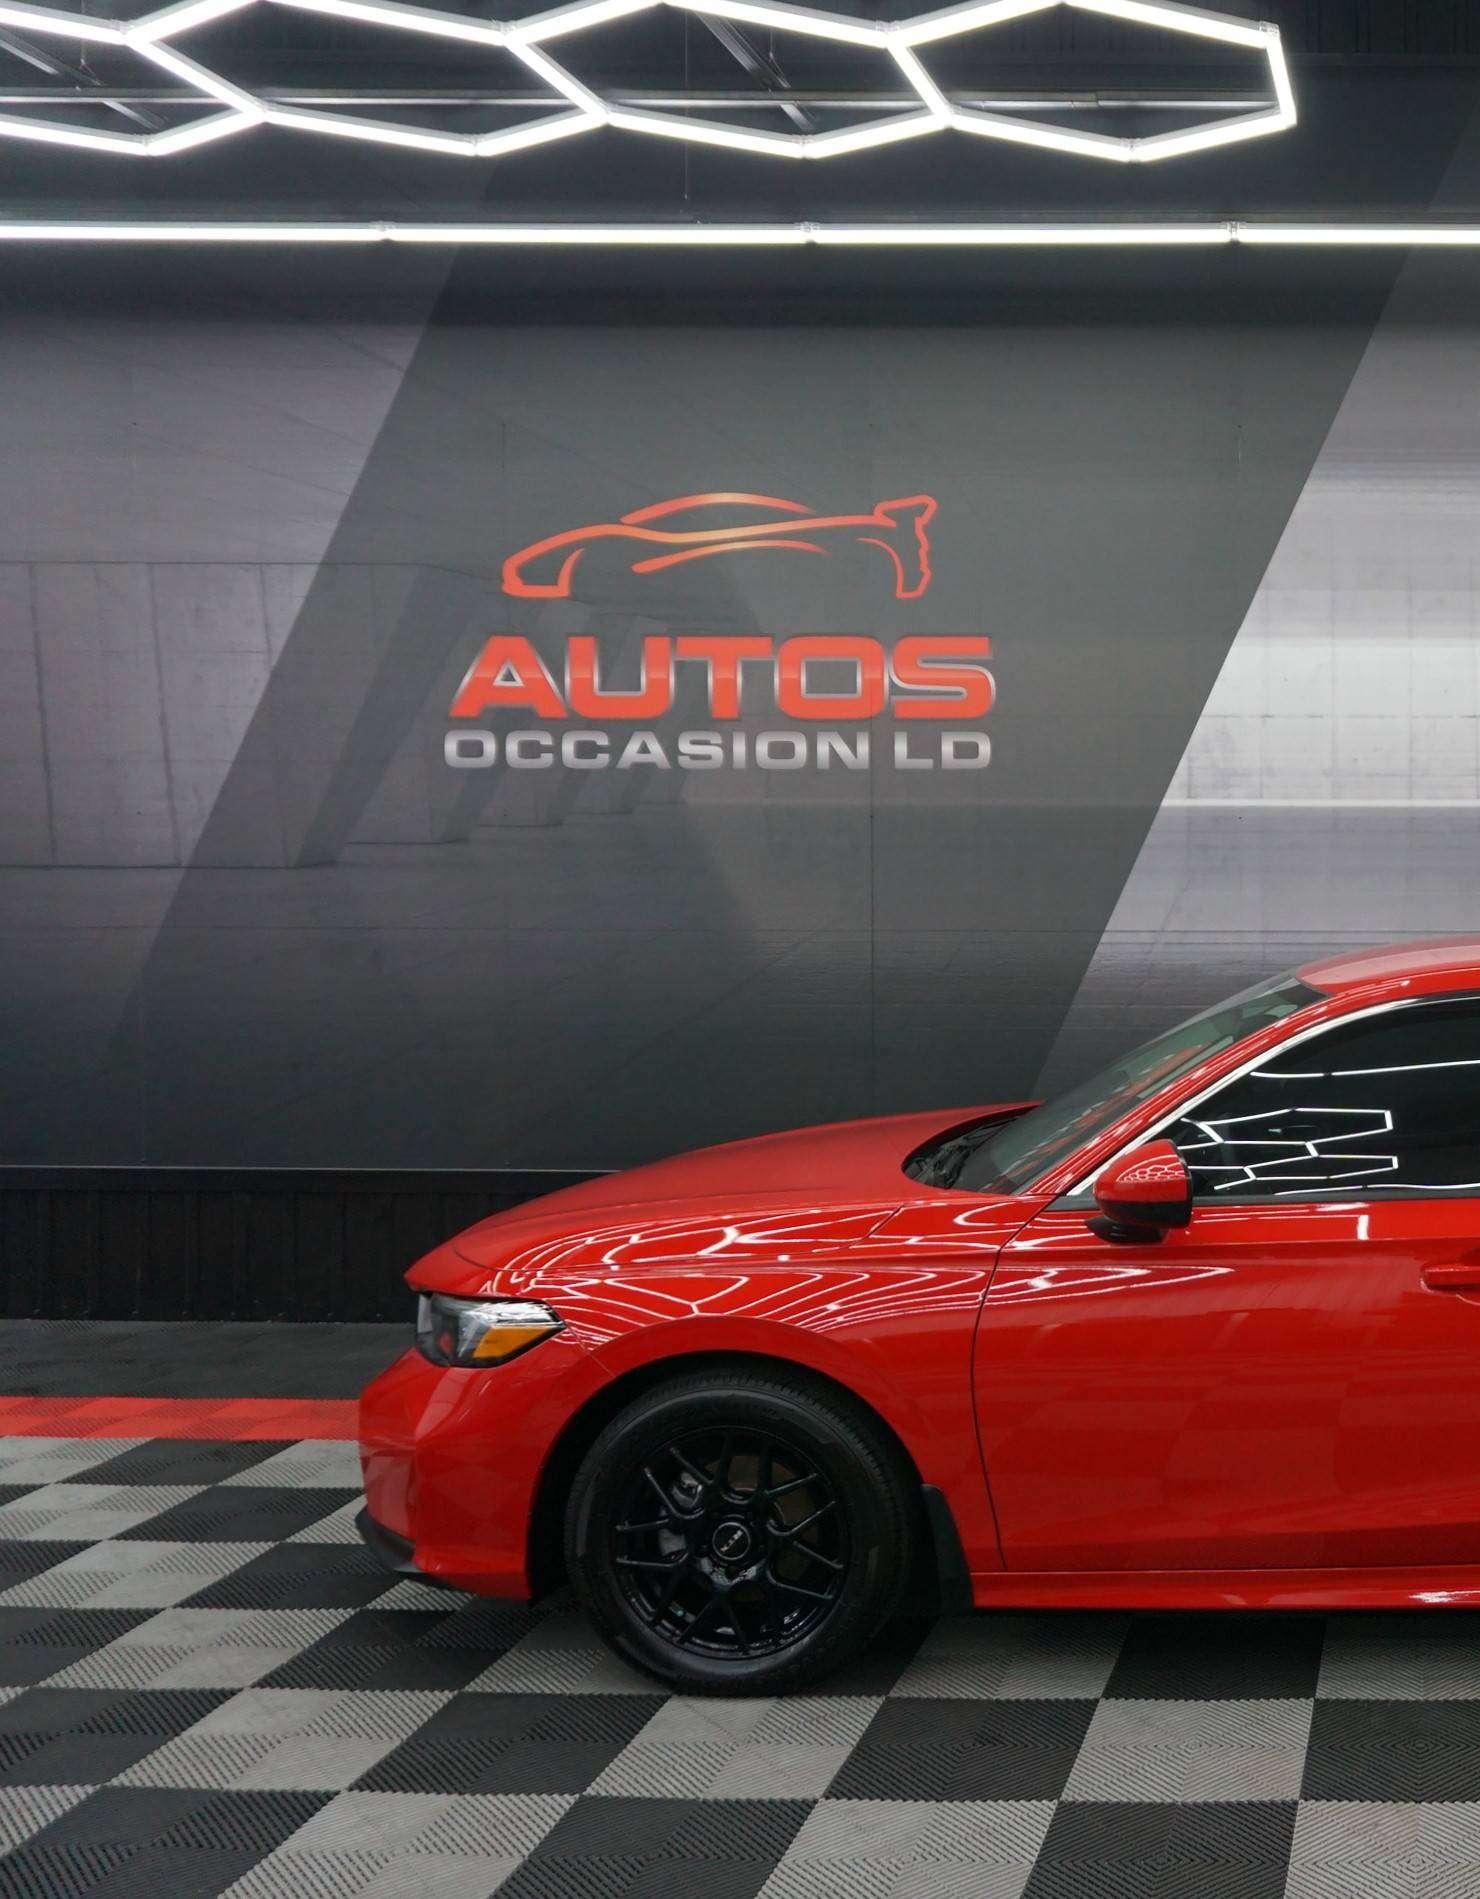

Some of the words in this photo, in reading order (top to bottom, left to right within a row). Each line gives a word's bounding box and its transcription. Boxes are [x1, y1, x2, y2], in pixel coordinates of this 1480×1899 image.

[449, 635, 996, 720] AUTOS
[443, 730, 871, 770] OCCASION
[893, 730, 992, 770] LD
